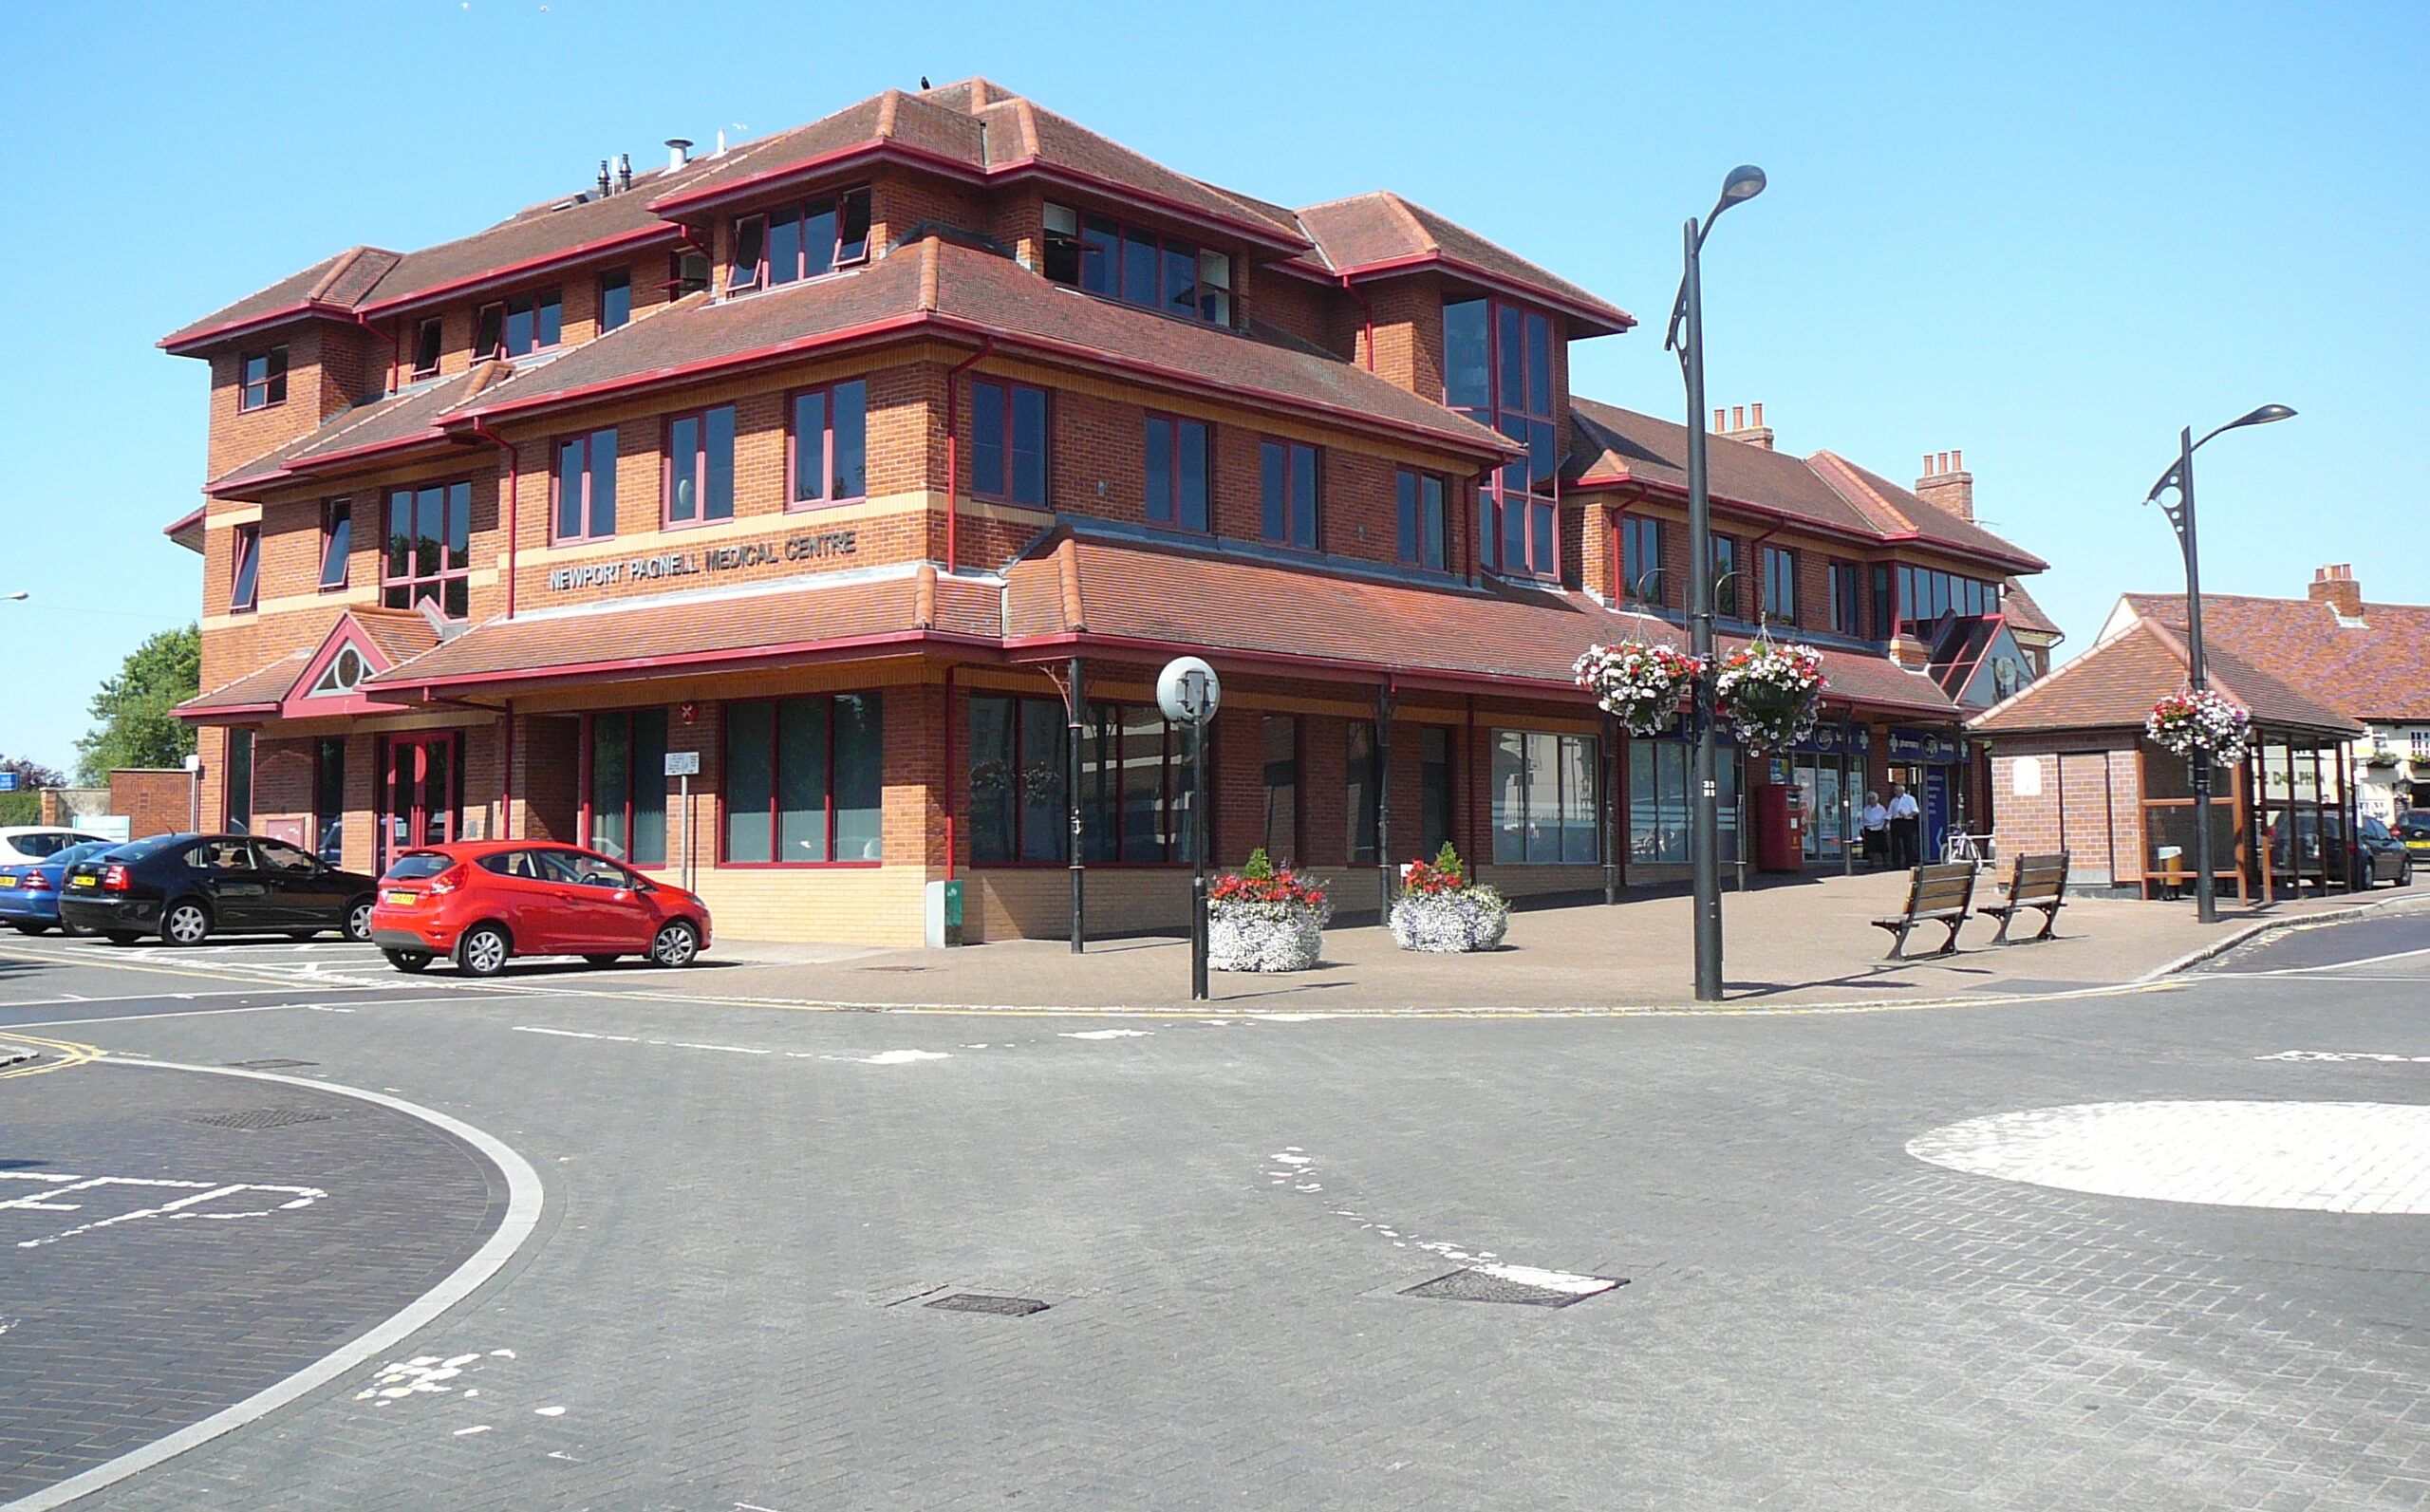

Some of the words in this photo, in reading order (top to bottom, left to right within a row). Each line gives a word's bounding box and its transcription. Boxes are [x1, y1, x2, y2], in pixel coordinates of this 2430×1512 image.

[550, 562, 624, 591] NEWPORT
[630, 553, 701, 580] PAGNELL
[705, 543, 778, 572] MEDICAL
[784, 531, 856, 560] CENTRE
